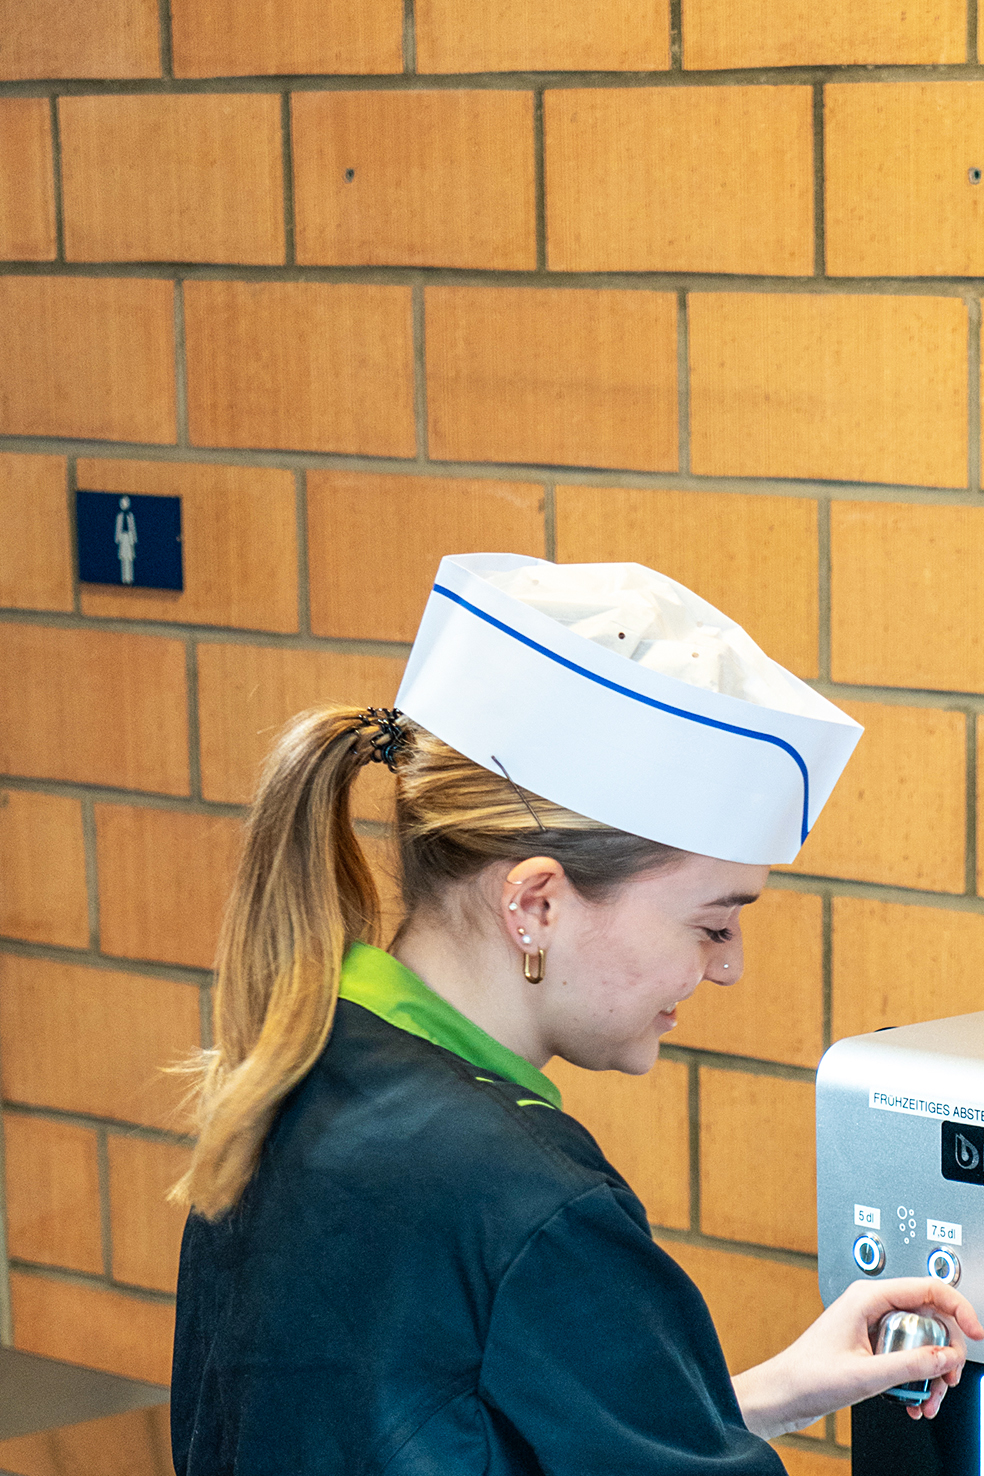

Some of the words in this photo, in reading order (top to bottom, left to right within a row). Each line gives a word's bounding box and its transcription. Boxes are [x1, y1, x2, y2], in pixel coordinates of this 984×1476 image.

[873, 1092, 950, 1116] FRÜHZEITIGES
[858, 1211, 866, 1222] 5
[867, 1212, 874, 1224] dl
[931, 1226, 946, 1240] 7,5
[947, 1228, 956, 1240] dl
